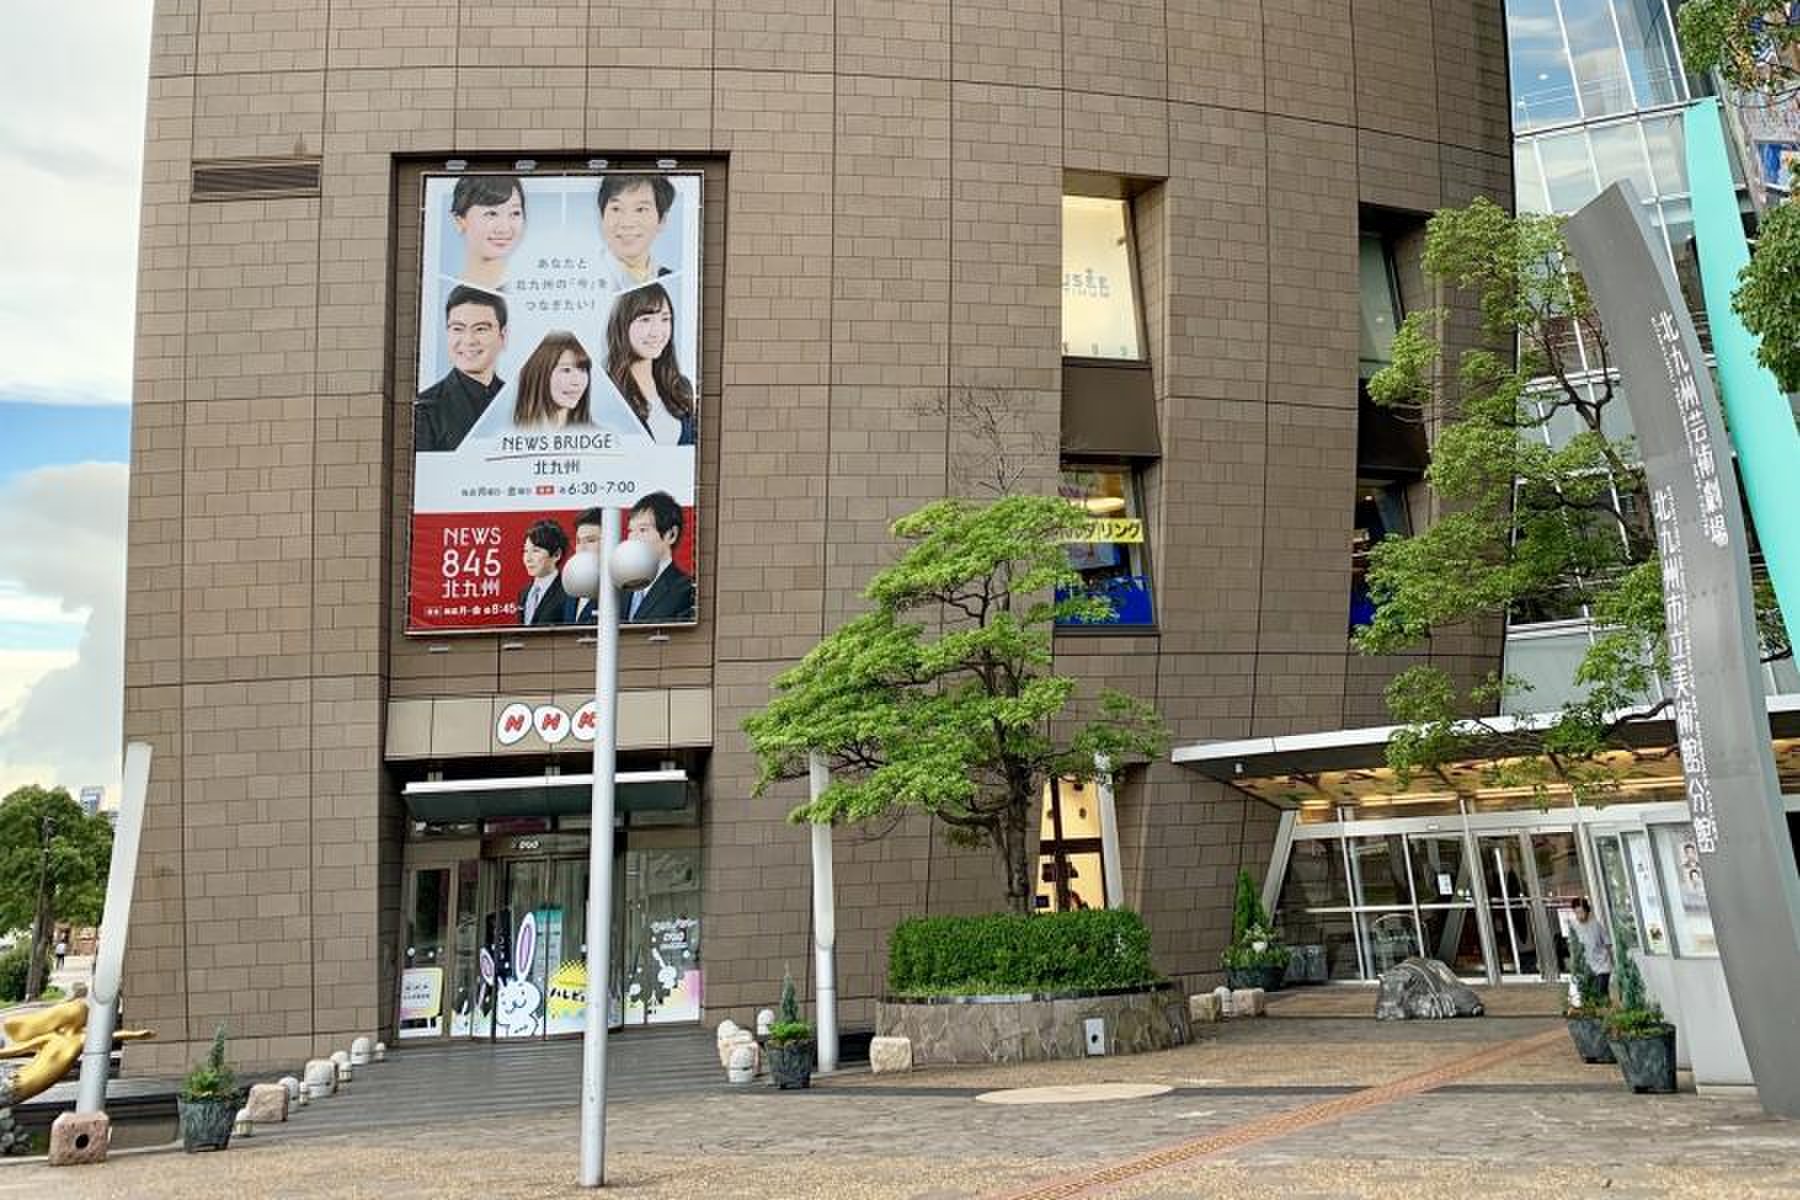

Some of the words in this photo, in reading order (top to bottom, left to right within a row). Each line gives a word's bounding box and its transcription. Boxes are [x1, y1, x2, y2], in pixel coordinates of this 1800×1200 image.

[502, 436, 549, 451] NEWS
[553, 433, 613, 450] BRIDGE
[533, 459, 580, 475] 北九州
[443, 527, 502, 546] NEWS
[442, 548, 501, 578] 845
[441, 579, 500, 598] 北九州
[504, 711, 597, 733] NHK
